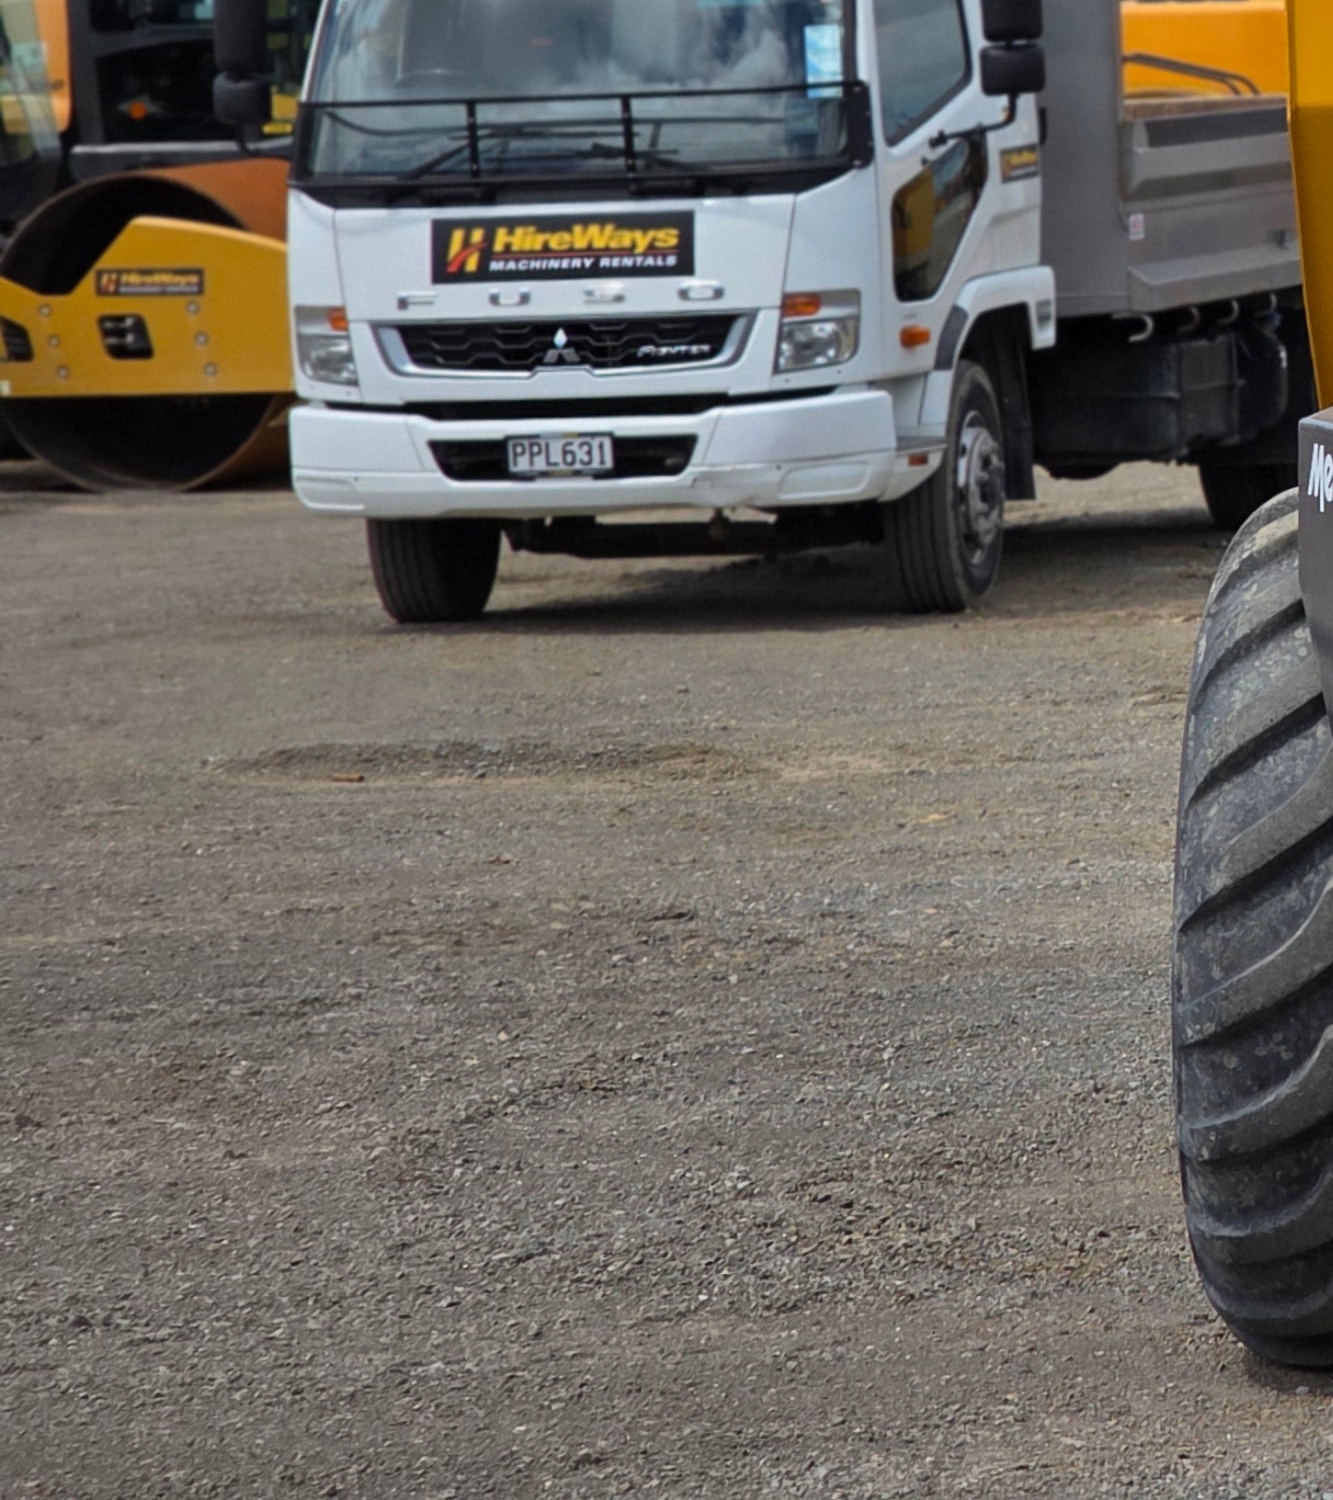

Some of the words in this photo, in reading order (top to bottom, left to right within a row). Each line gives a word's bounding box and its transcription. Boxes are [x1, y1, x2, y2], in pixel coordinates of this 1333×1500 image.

[493, 222, 680, 255] HireWays
[489, 257, 595, 272] MACHINERY
[599, 254, 678, 268] RENTALS
[397, 280, 725, 311] FUSO
[511, 440, 606, 468] PPL631
